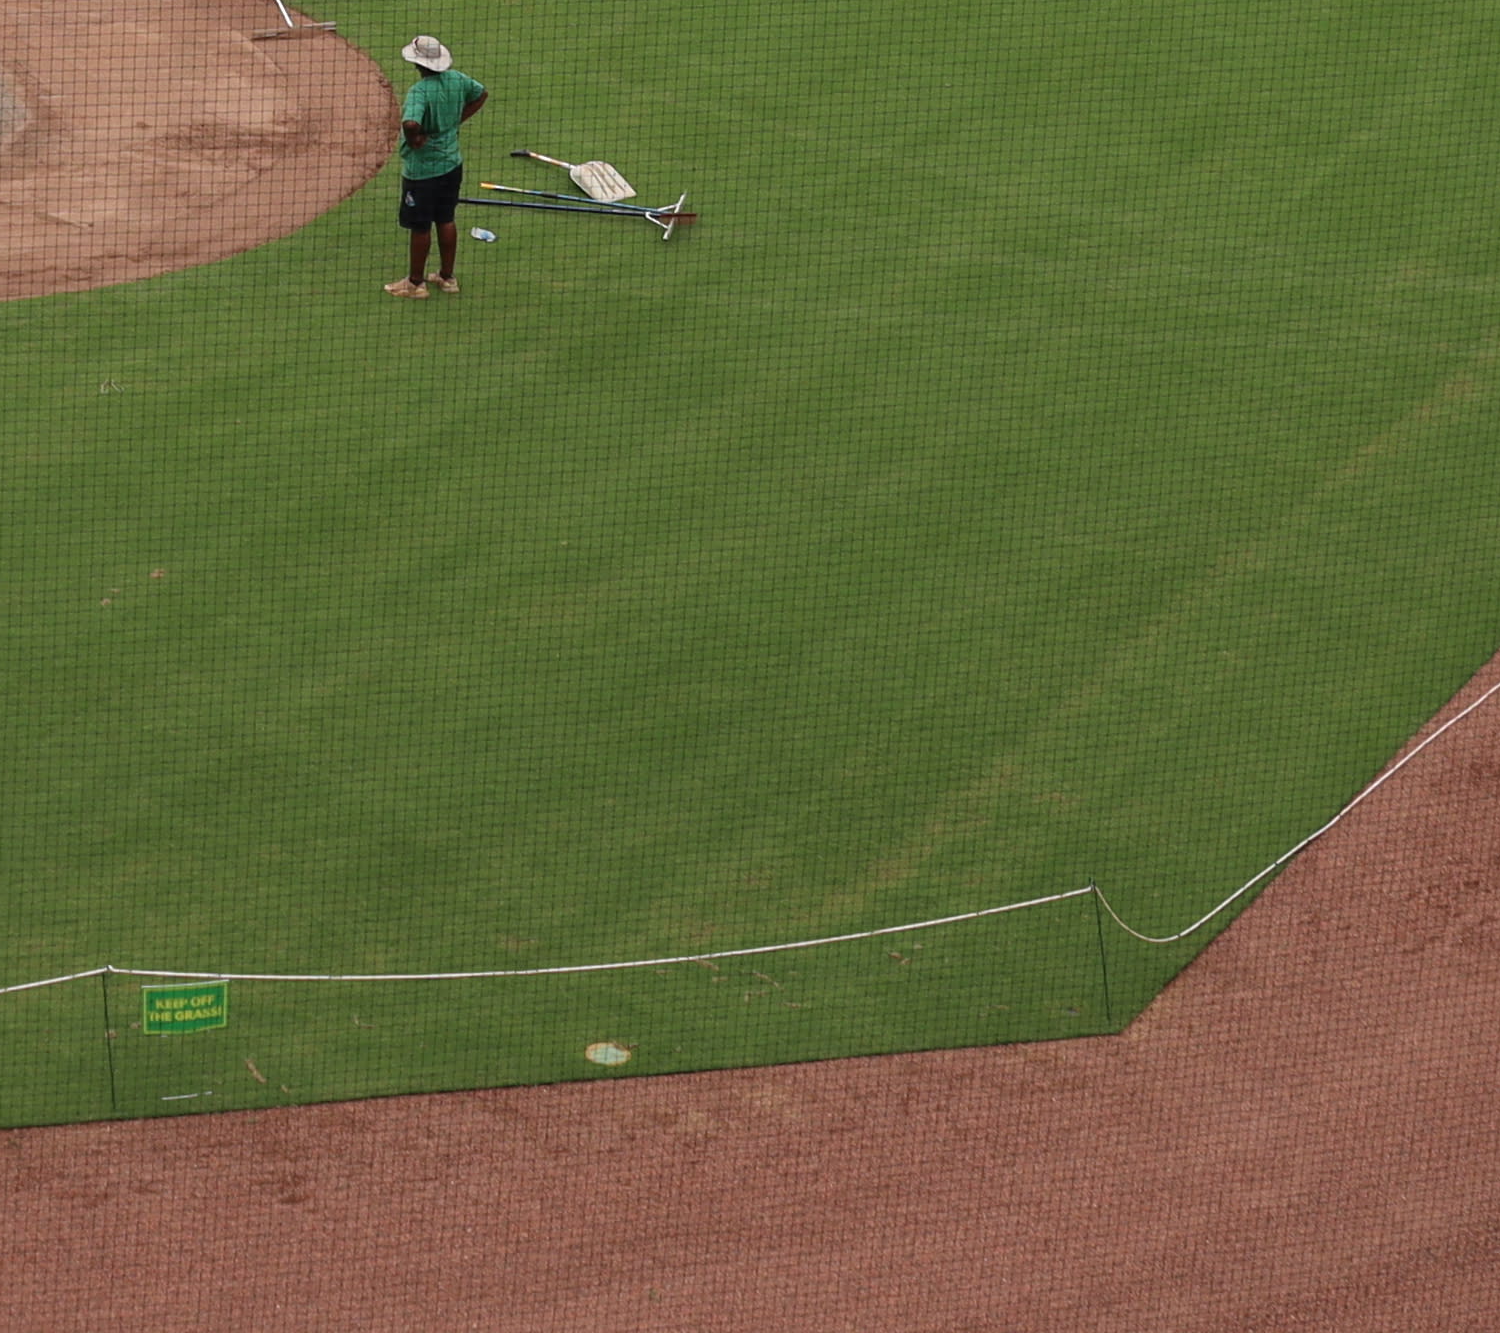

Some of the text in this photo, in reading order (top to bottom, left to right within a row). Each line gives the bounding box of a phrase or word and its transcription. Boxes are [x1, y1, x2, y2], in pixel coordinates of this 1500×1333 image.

[156, 995, 215, 1010] KEEP OFF
[150, 1007, 222, 1022] THE GRASS!
